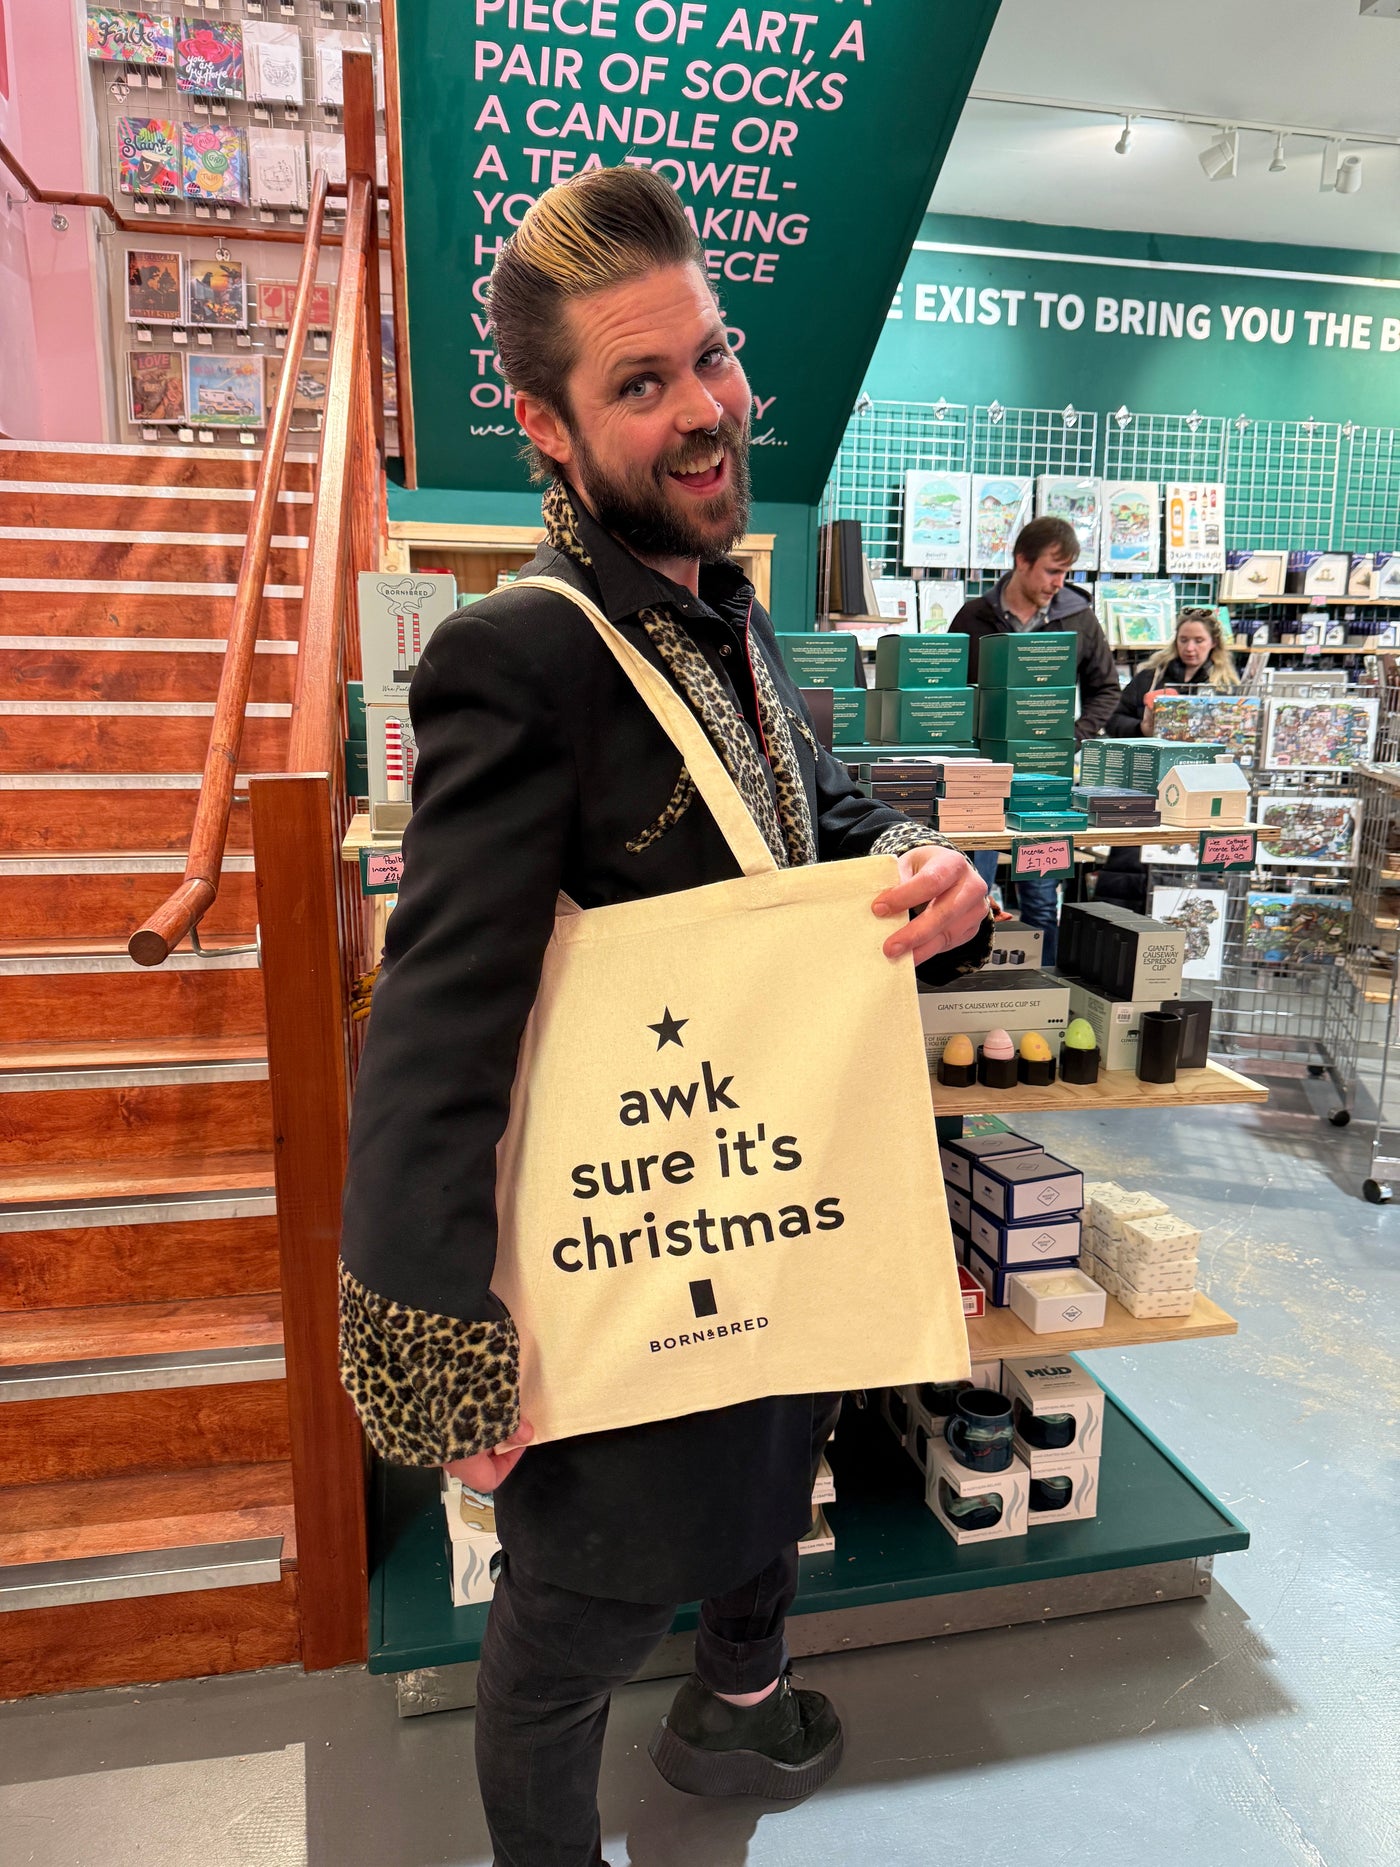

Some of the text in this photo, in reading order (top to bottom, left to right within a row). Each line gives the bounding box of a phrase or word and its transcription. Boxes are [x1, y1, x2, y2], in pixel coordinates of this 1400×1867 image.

[475, 0, 866, 65] PIECE OF ART, A
[474, 40, 849, 112] PAIR OF SOCKS
[474, 94, 799, 157] A CANDLE OR
[473, 145, 508, 181] A
[704, 249, 780, 284] ECE
[914, 283, 1026, 327] EXIST
[1033, 291, 1086, 331] TO
[1095, 296, 1212, 341] BRING
[1220, 304, 1296, 345] YOU
[1303, 310, 1374, 351] THE
[1380, 317, 1400, 352] B
[138, 353, 170, 369] LOVE
[470, 424, 515, 436] we
[383, 855, 403, 865] Poolb
[1026, 857, 1058, 869] £7.90
[1143, 957, 1177, 965] ESPRESSO
[1147, 944, 1175, 952] GIANT'S
[937, 1003, 963, 1011] GIANT'S
[964, 1001, 999, 1010] CAUSEWAY
[619, 1060, 740, 1127] awk
[571, 1122, 803, 1200] sure it's
[552, 1196, 845, 1273] christmas
[649, 1316, 770, 1353] BORN&BRED
